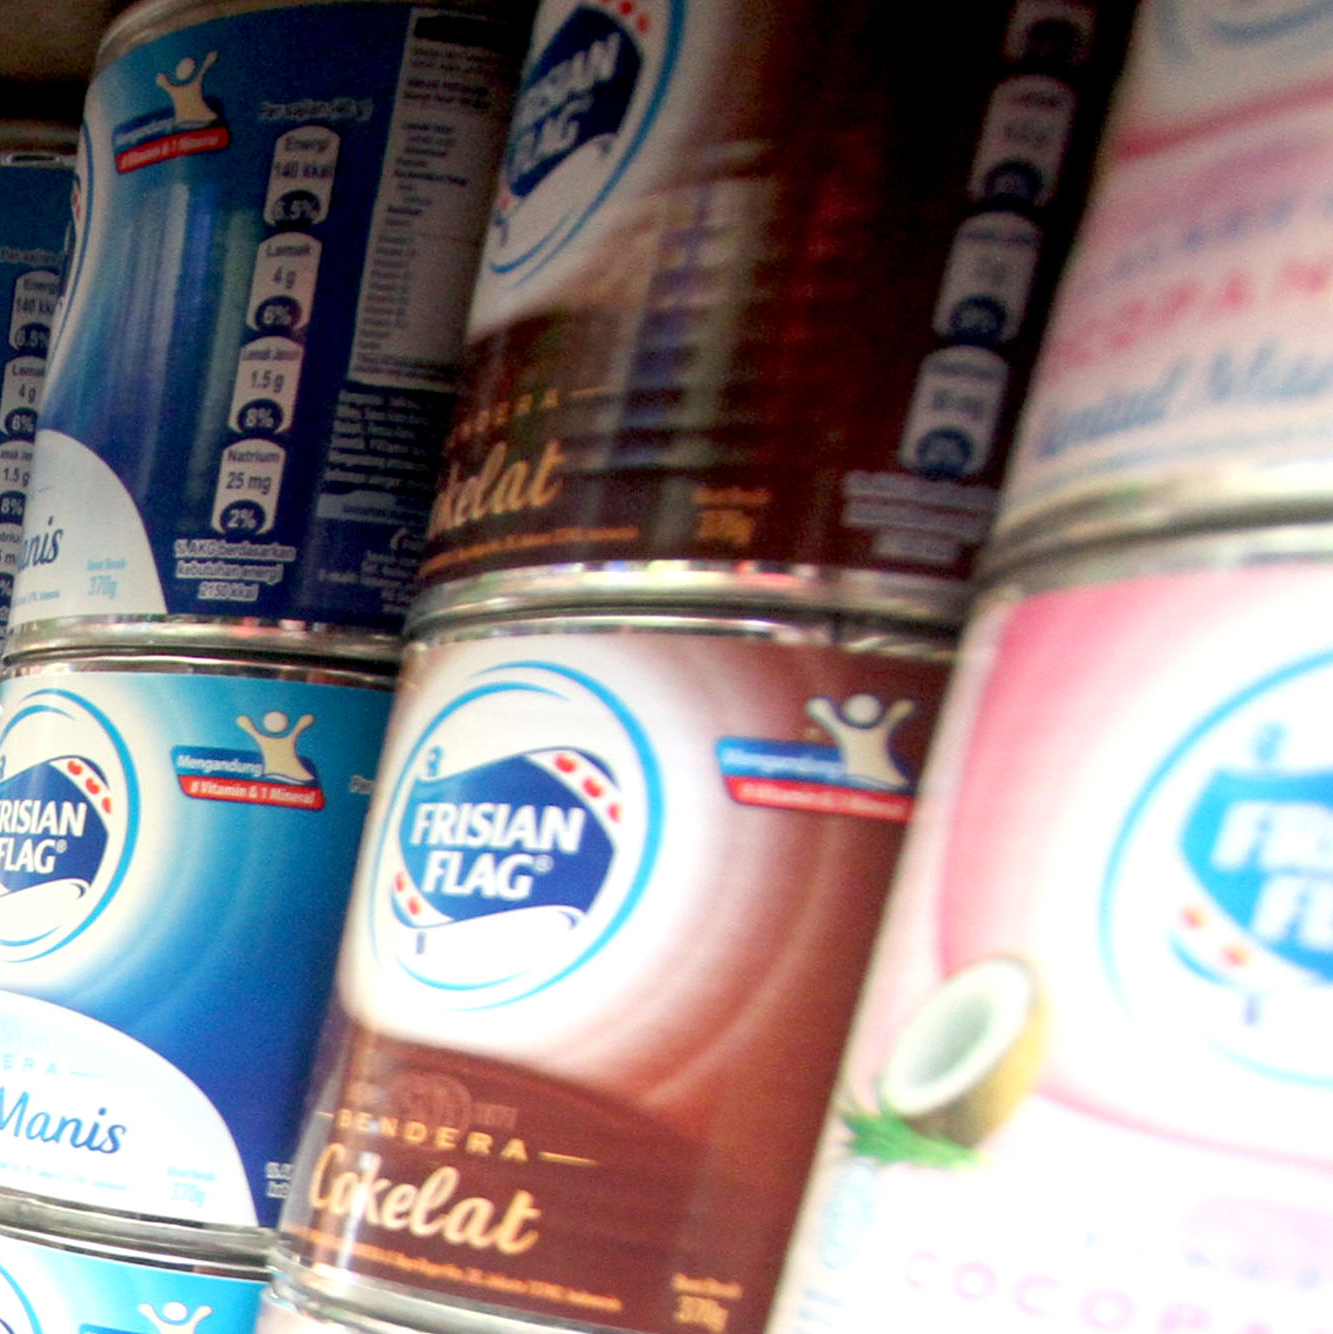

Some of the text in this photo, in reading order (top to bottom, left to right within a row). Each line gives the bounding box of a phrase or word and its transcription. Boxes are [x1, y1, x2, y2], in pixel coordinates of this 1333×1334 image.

[273, 268, 297, 289] 4 g
[263, 304, 291, 323] 6%
[250, 370, 284, 393] 1.5 g
[245, 407, 275, 427] 8%
[226, 449, 280, 463] Natrium
[3, 468, 20, 482] 1.5
[225, 471, 272, 494] 25 mg
[430, 440, 565, 530] kelat
[230, 509, 256, 529] 2%
[409, 801, 587, 855] FRISIAN
[337, 1107, 528, 1163] BENDERA
[308, 1142, 542, 1256] Cokelat
